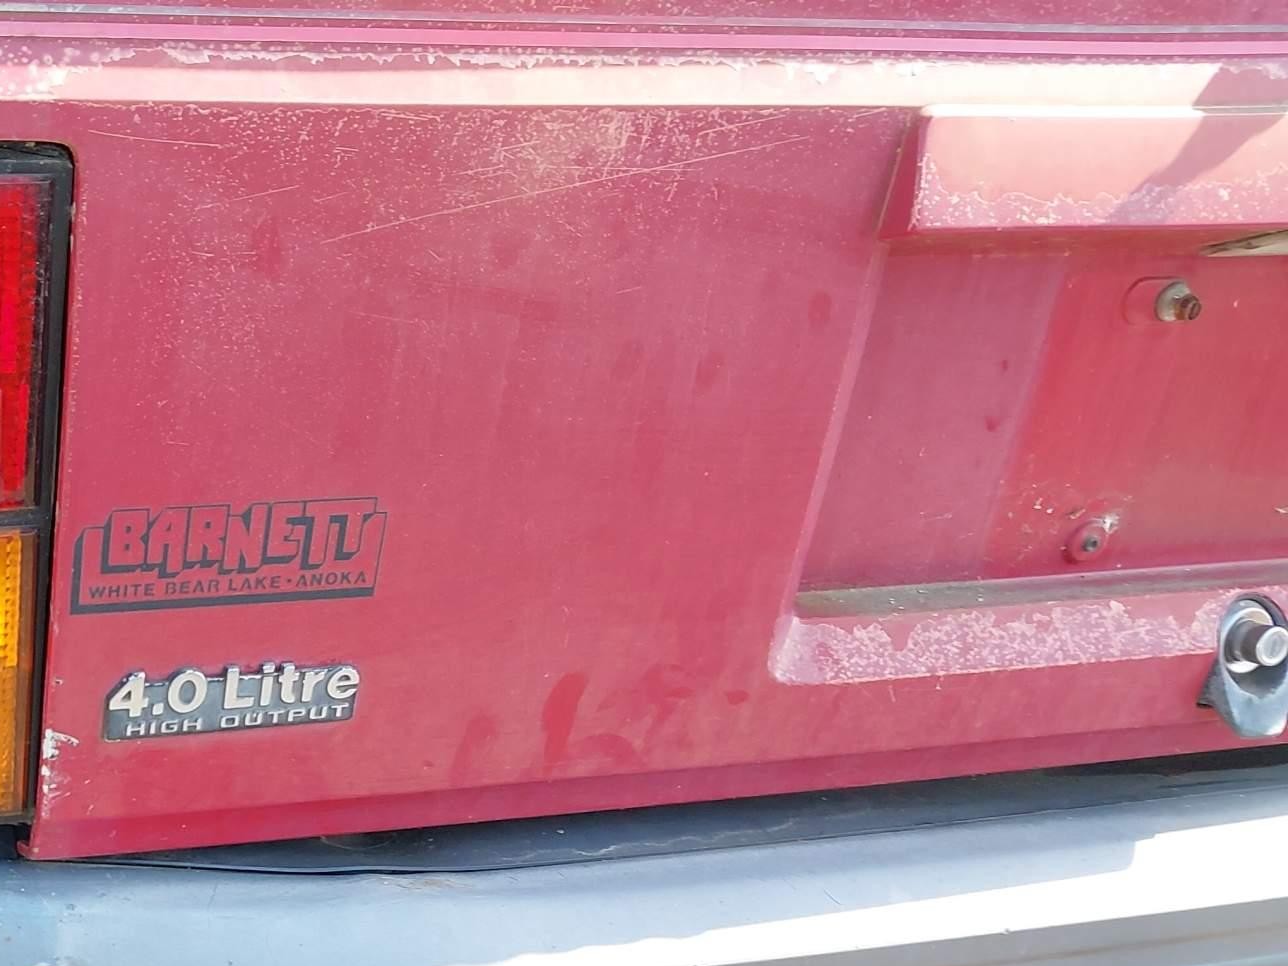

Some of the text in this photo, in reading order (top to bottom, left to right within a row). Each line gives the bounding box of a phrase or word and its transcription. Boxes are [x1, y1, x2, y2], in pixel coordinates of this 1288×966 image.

[101, 497, 378, 579] BARNETT
[88, 570, 367, 600] WHITE BEAR LAKE ANOKA
[108, 662, 361, 718] 4.0 Litre
[124, 702, 350, 738] HIGH OUTPUT
